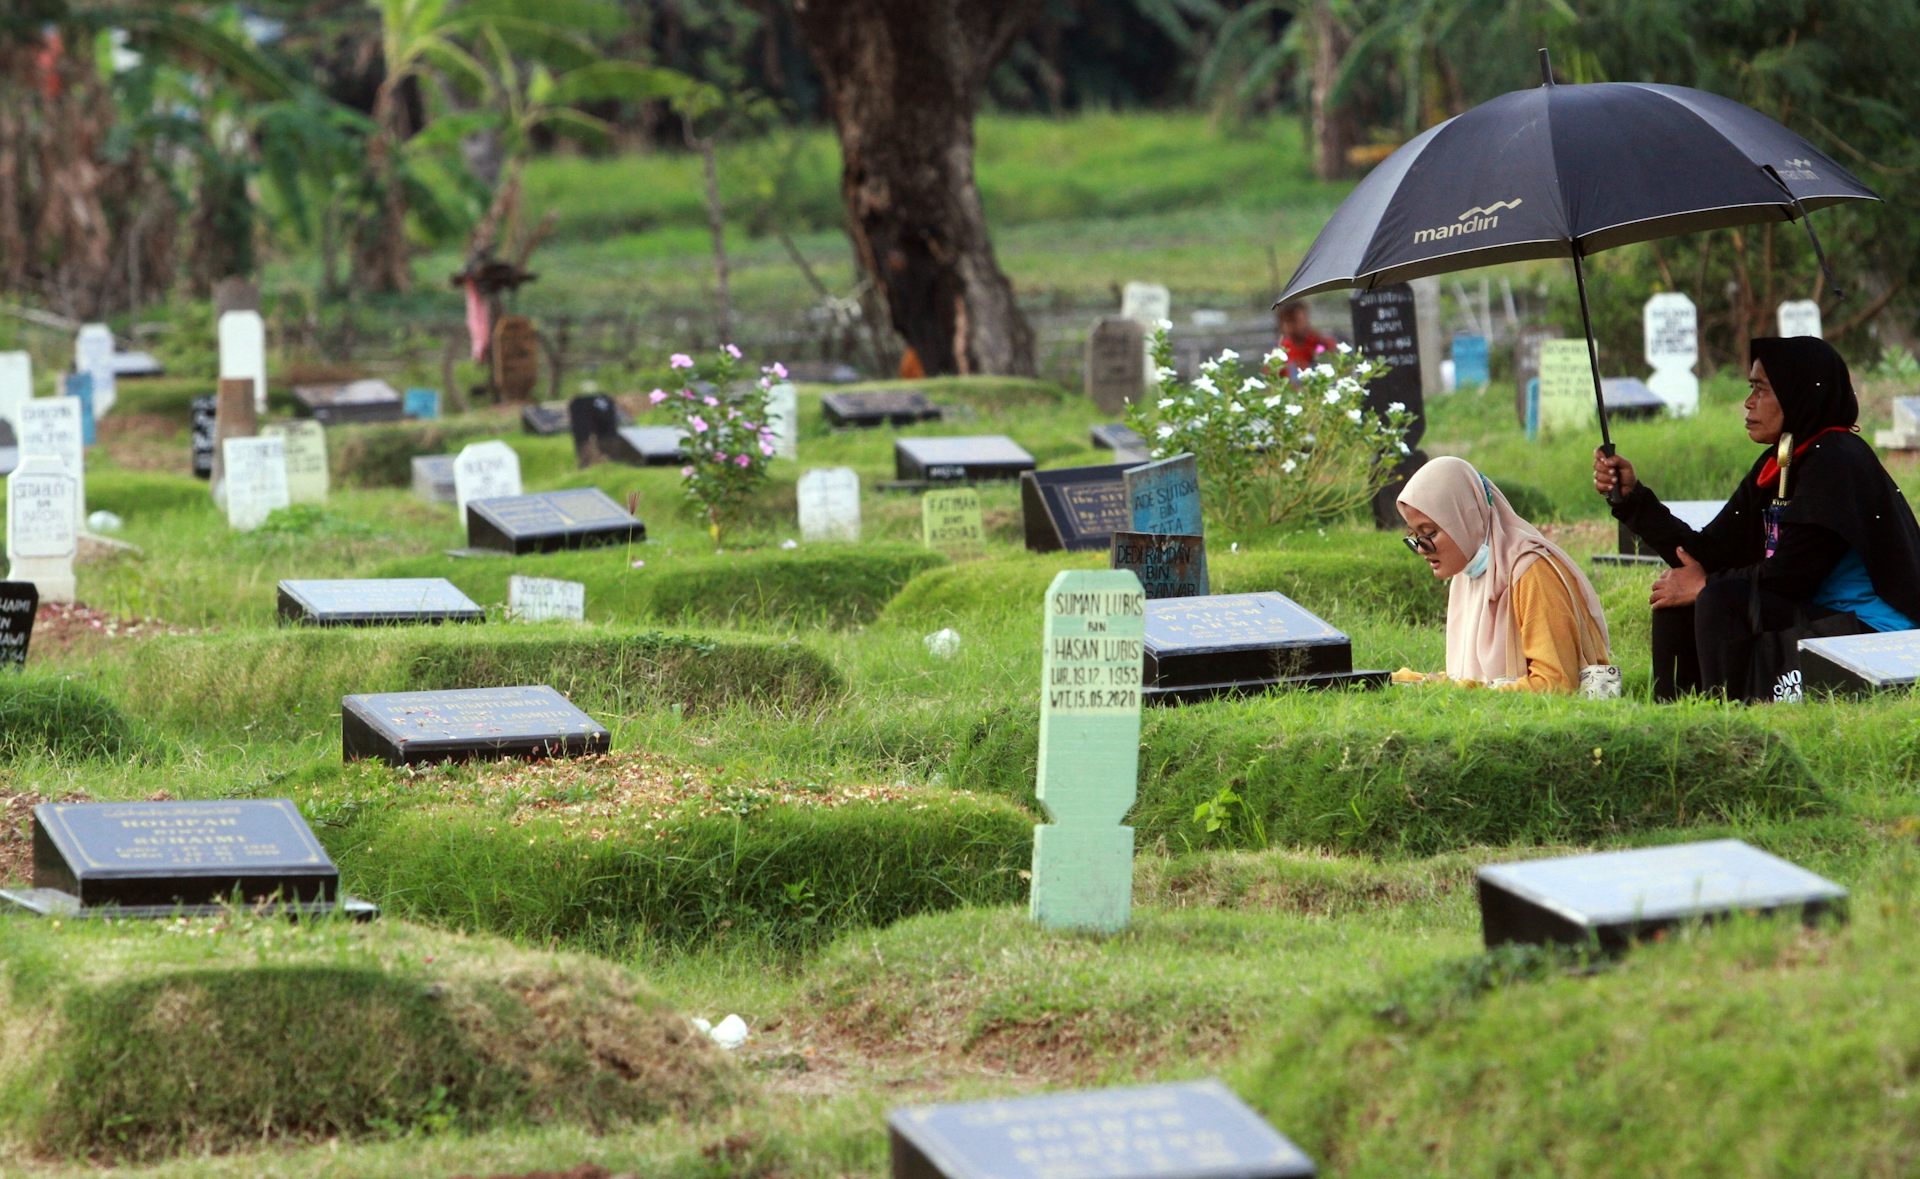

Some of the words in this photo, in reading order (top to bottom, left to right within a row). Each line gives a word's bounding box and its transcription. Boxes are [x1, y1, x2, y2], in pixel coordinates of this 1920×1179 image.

[1413, 215, 1499, 244] mandiri
[1159, 503, 1178, 519] BIN
[1149, 518, 1184, 534] TATA
[1117, 544, 1143, 564] DEDI
[1145, 565, 1169, 580] BIN
[1055, 593, 1100, 615] SUMAN
[1105, 593, 1144, 616] LUBIS
[1087, 621, 1106, 632] BIN
[1055, 638, 1099, 660] HASAN
[1104, 639, 1140, 661] LUBIS
